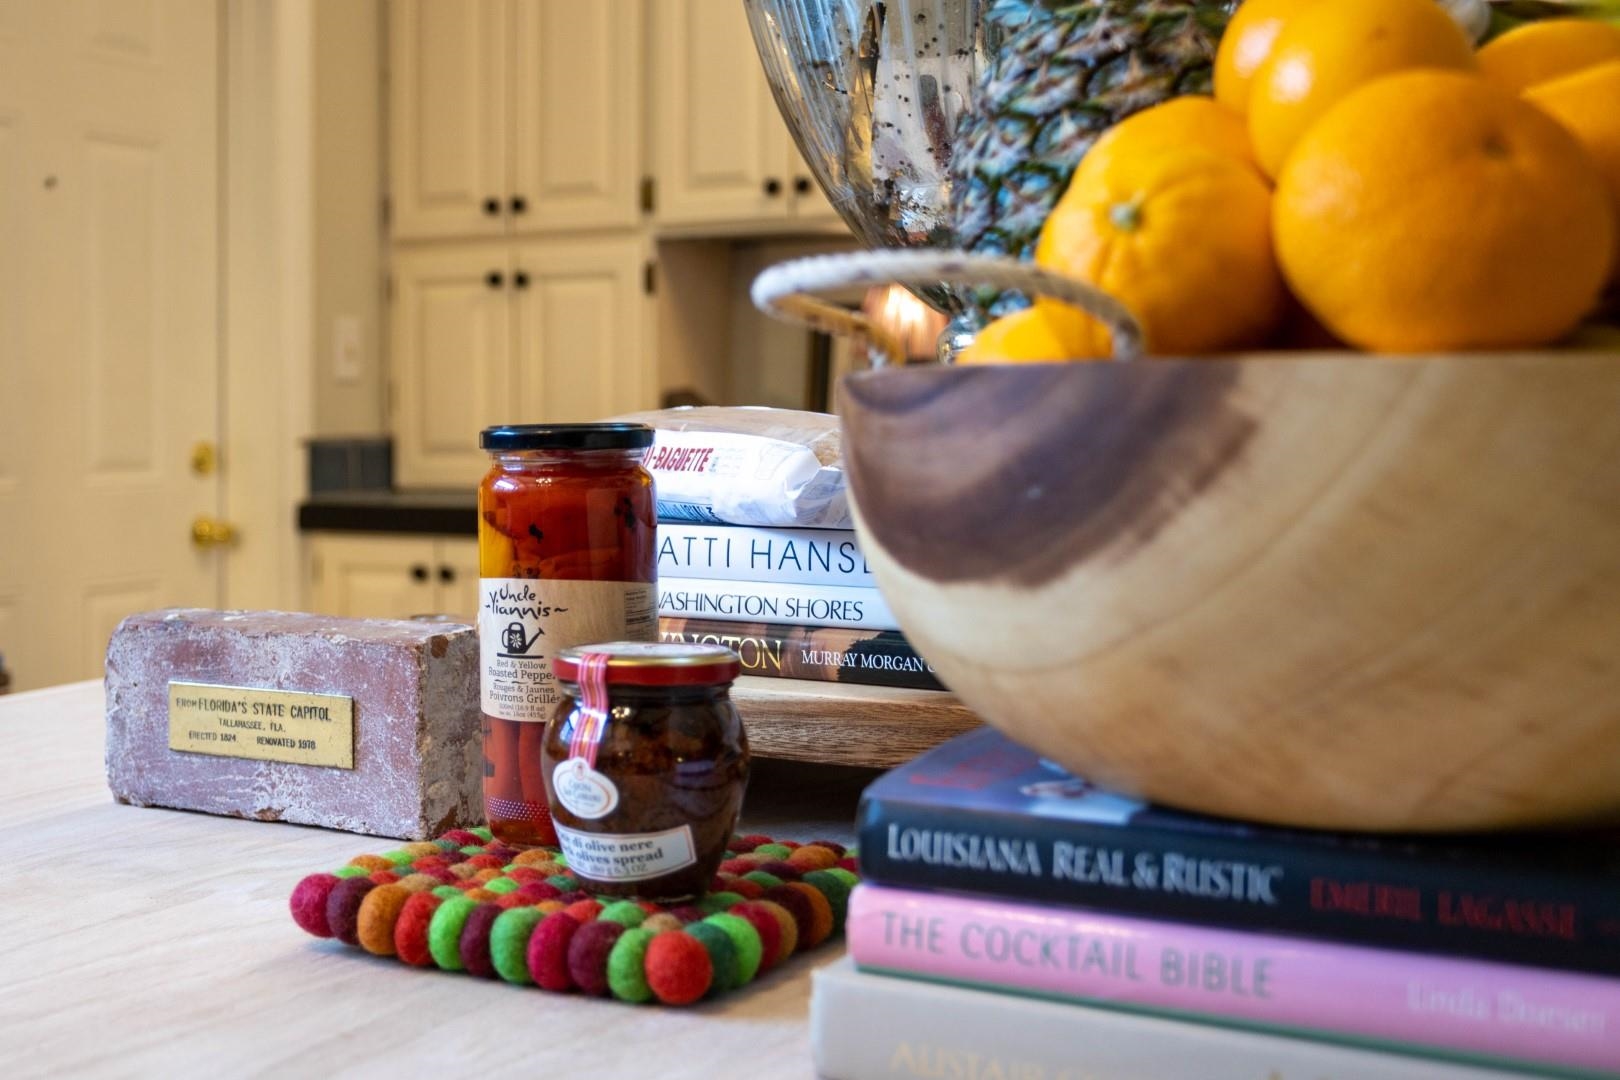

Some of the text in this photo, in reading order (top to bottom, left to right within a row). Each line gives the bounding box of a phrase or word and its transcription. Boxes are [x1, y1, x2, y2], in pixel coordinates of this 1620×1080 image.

[488, 583, 552, 620] Uncle Yiannis
[784, 597, 864, 622] SHORES
[519, 660, 547, 671] Yellow
[801, 650, 858, 668] MURRAY
[860, 653, 925, 673] MORGAN
[488, 666, 557, 682] Roasted Peppe
[489, 690, 524, 703] Poivrons
[526, 685, 555, 694] Jaunes
[199, 697, 248, 714] FLORIDA'S
[253, 702, 285, 717] STATE
[290, 704, 331, 721] CAPITOL
[188, 730, 218, 742] ERECTED
[256, 735, 296, 749] RENOVATED
[585, 839, 616, 853] olive
[618, 840, 654, 852] nere
[613, 847, 664, 867] spread
[887, 823, 1042, 877] LOUISIANA
[1052, 840, 1129, 887] REAL
[1131, 851, 1160, 891] &
[1163, 852, 1284, 905] RUSTIC
[880, 910, 944, 955] THE
[959, 921, 1146, 982] COCKTAIL
[1159, 945, 1275, 998] BIBLE
